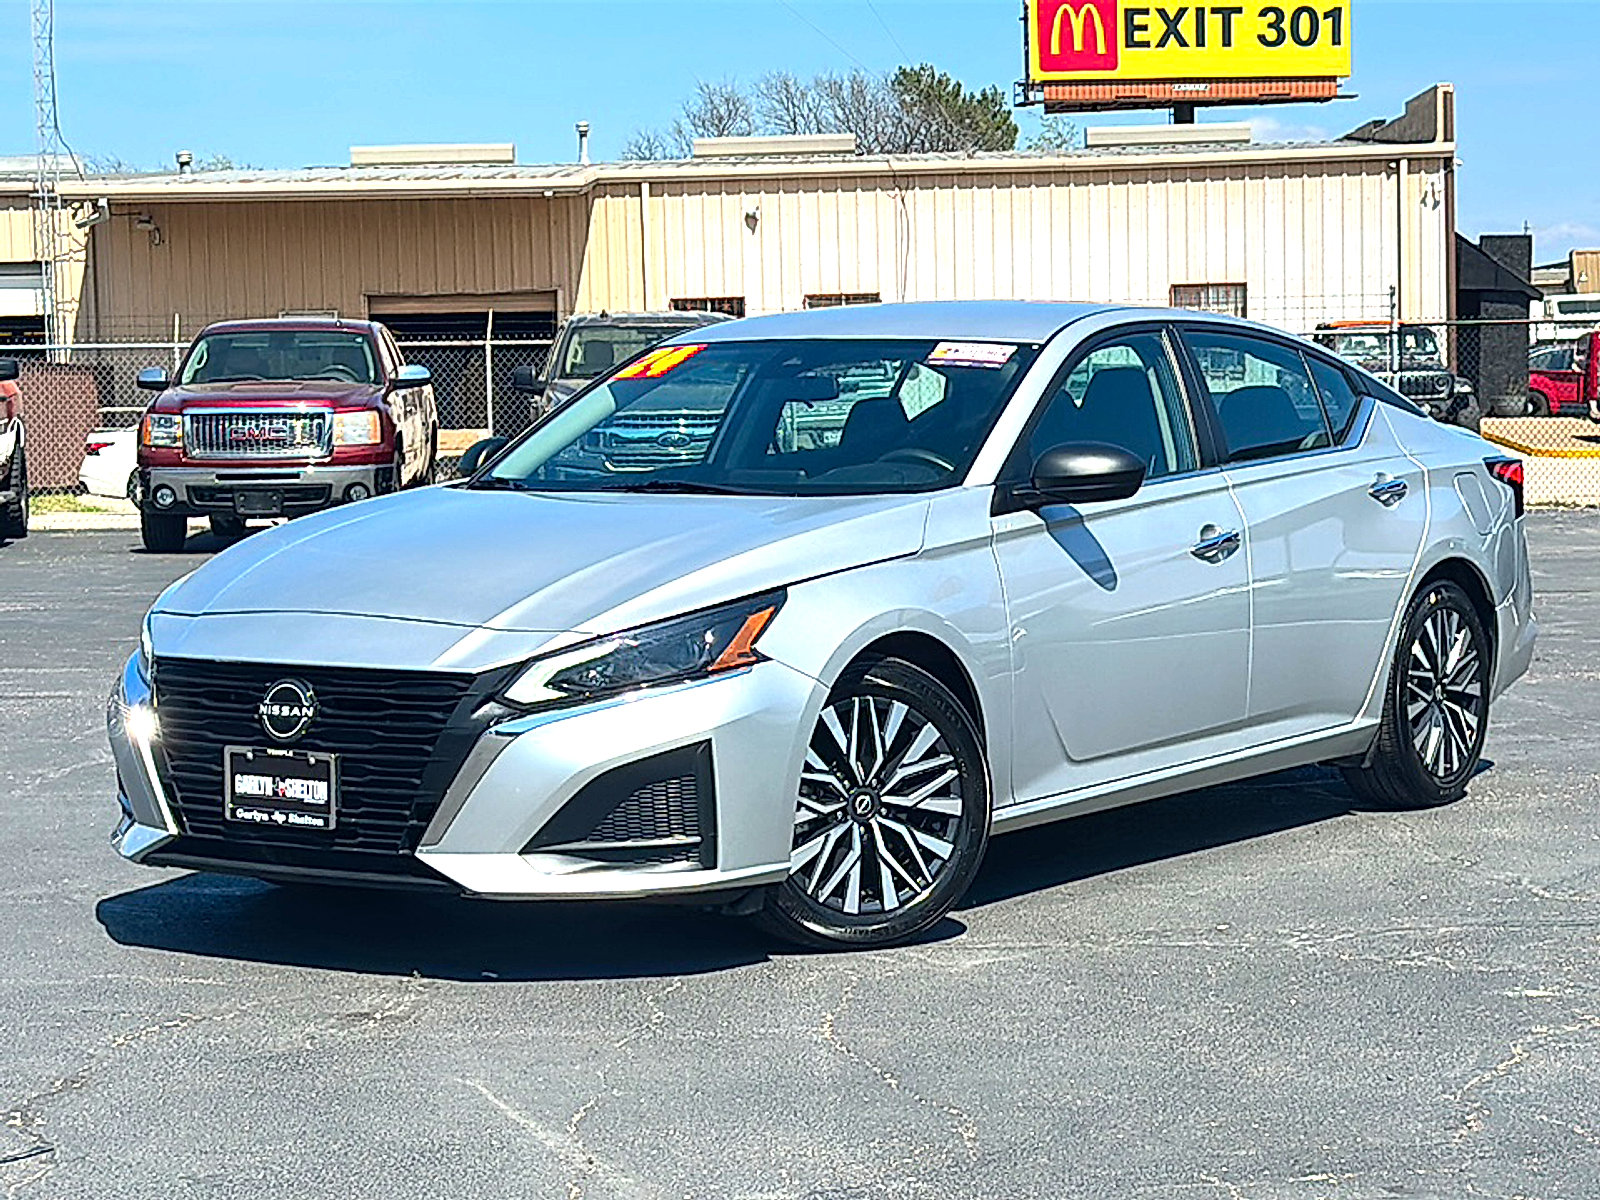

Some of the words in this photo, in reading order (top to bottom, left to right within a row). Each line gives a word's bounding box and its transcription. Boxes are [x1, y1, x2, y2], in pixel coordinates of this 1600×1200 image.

[1124, 6, 1243, 48] EXIT
[1256, 6, 1344, 48] 301
[228, 425, 288, 441] GMC
[259, 704, 314, 717] NISSAN
[284, 777, 328, 801] SHELTON
